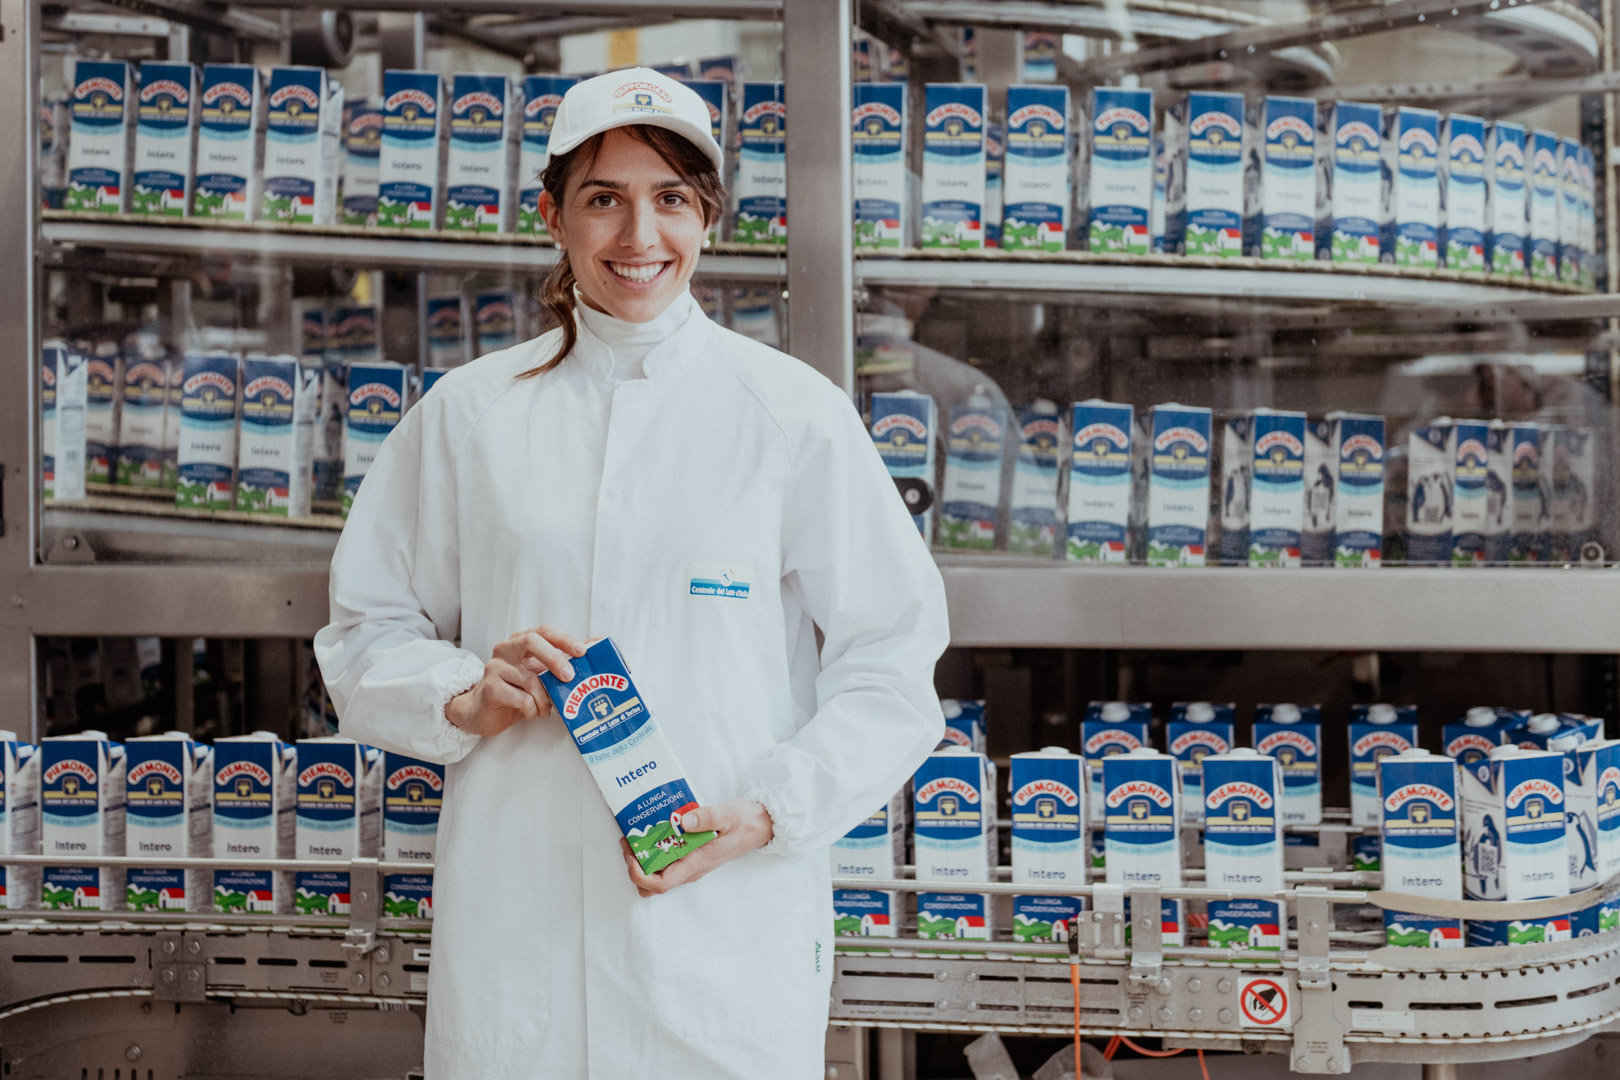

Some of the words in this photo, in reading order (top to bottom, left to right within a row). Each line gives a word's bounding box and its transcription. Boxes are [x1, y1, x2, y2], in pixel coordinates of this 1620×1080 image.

[566, 675, 625, 714] PIEMONTE
[580, 729, 599, 742] Centrale
[608, 718, 620, 727] Latte
[626, 706, 640, 718] Torino
[595, 752, 610, 762] latte
[612, 744, 627, 755] della
[628, 724, 653, 746] Centrale
[47, 761, 96, 781] PIEMONTE
[131, 761, 180, 781] PIEMONTE
[219, 763, 268, 782] PIEMONTE
[302, 764, 351, 785] PIEMONTE
[390, 767, 440, 788] PIEMONTE
[616, 761, 656, 787] Intero
[643, 791, 666, 808] LUNGA
[920, 781, 976, 800] PIEMONTE
[1018, 782, 1075, 803] PIEMONTE
[1110, 784, 1169, 804] PIEMONTE
[1211, 785, 1270, 805] PIEMONTE
[1389, 787, 1449, 808] PIEMONTE
[1510, 782, 1560, 803] PIEMONTE
[628, 790, 684, 826] CONSERVAZIONE
[56, 841, 86, 850] Intero
[140, 842, 171, 851] Intero
[228, 844, 260, 853] Intero
[310, 846, 342, 855] Intero
[399, 850, 432, 860] Intero
[838, 864, 874, 874] Intero
[932, 867, 968, 876] Intero
[1029, 869, 1066, 879] Intero
[1124, 872, 1161, 881] Intero
[1223, 873, 1262, 883] Intero
[1403, 877, 1442, 886] Intero
